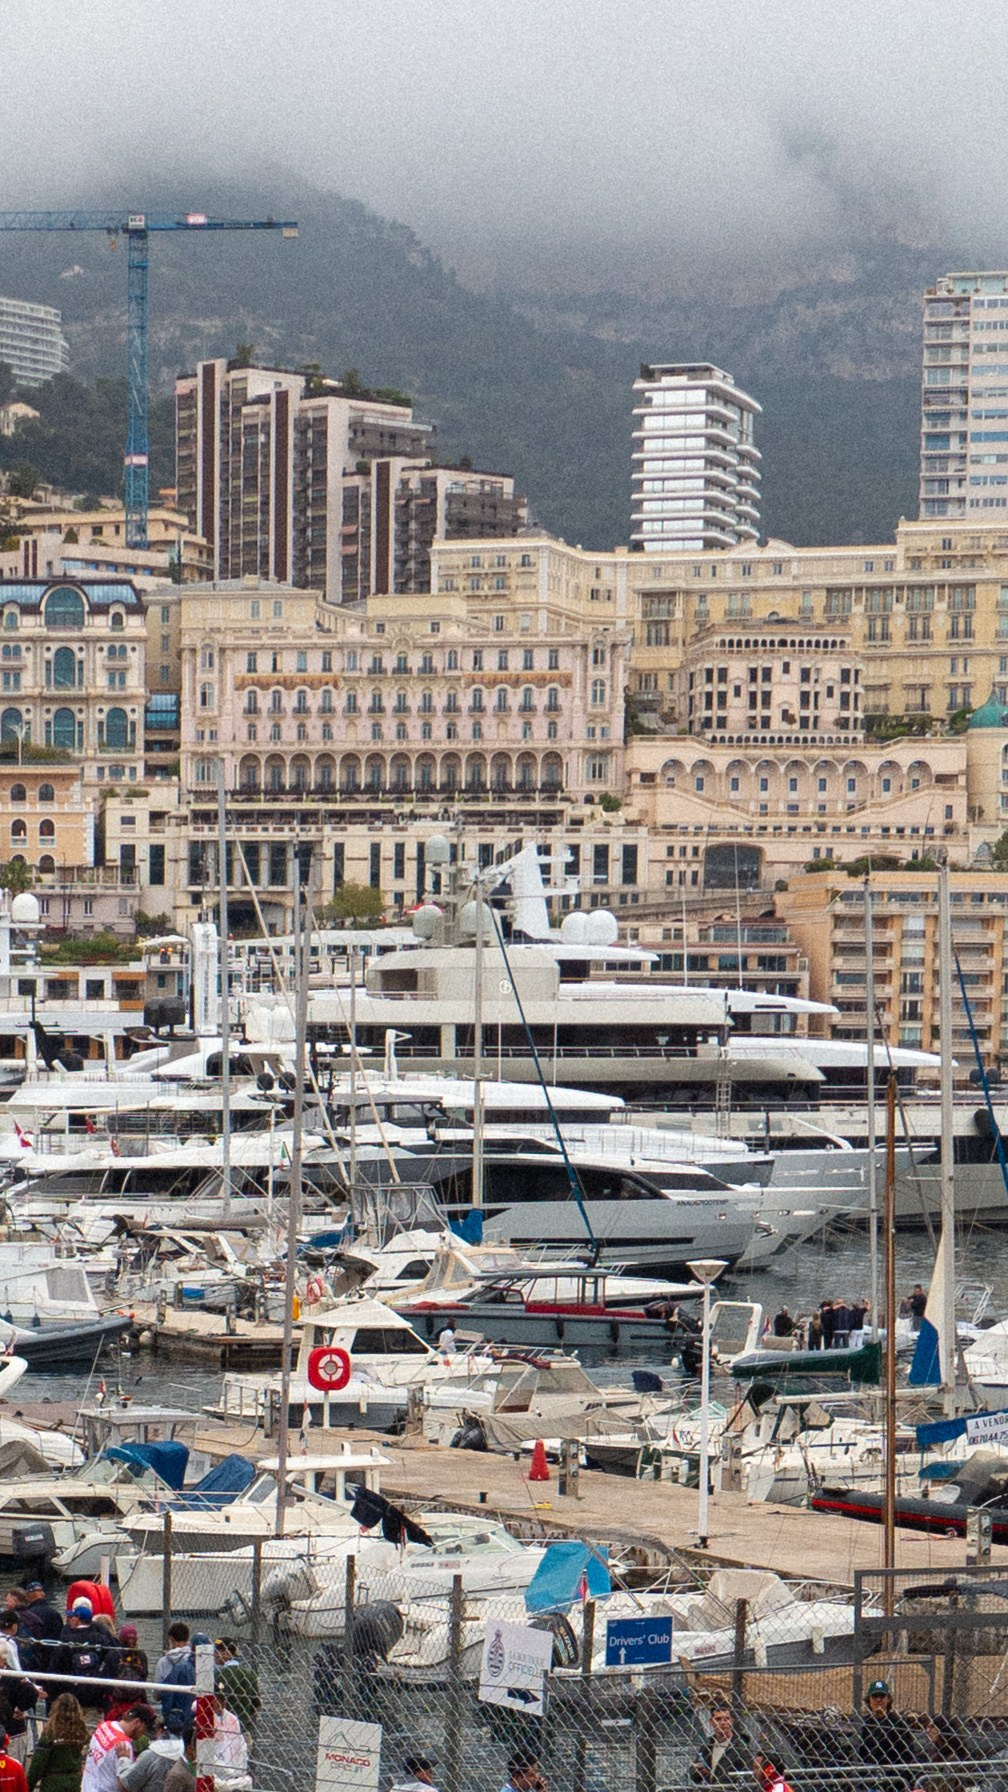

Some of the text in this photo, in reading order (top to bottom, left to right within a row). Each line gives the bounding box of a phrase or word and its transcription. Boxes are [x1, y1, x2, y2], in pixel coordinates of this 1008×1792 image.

[974, 1421, 980, 1430] A
[609, 1633, 670, 1647] Drivers' Club
[325, 1753, 370, 1767] MONACO
